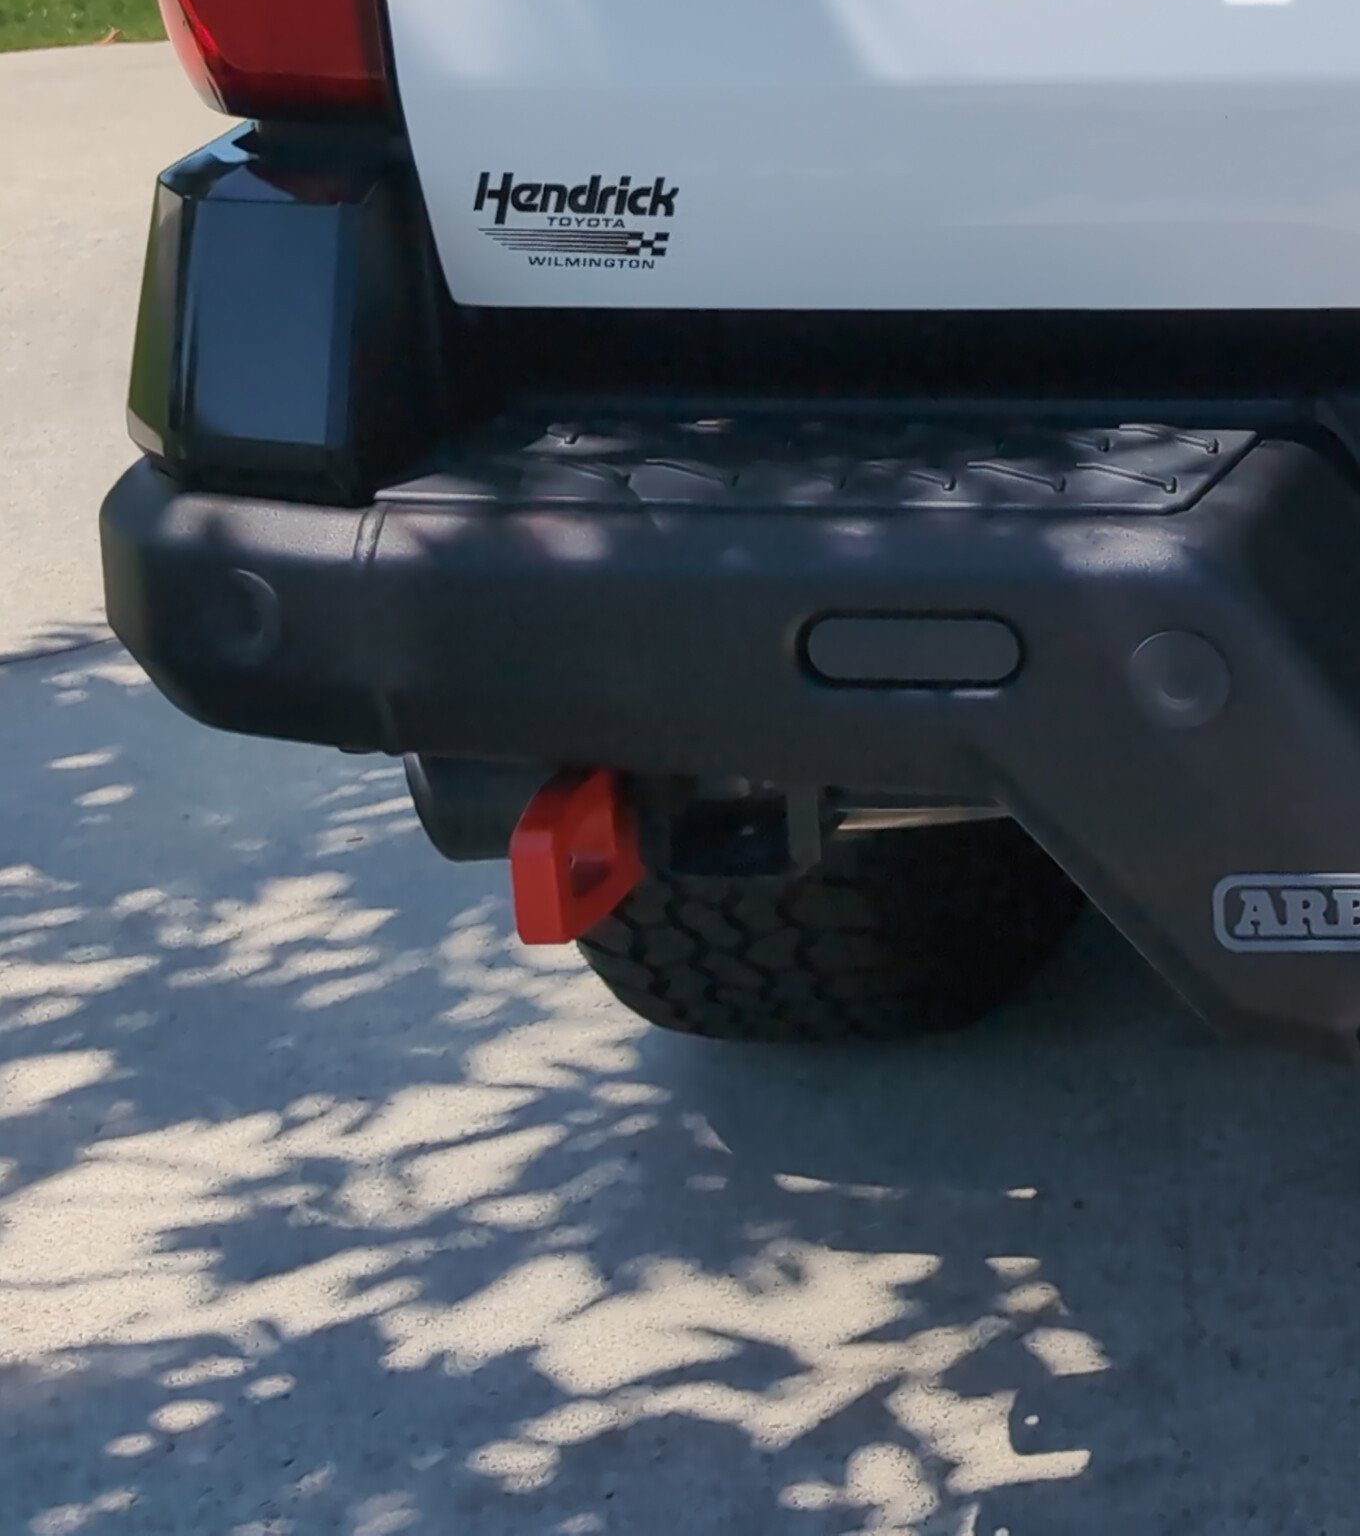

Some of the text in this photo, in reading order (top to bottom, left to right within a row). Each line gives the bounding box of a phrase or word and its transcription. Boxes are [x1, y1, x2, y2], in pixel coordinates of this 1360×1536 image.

[473, 171, 680, 226] Hendrick
[546, 216, 626, 229] TOYOTA
[528, 255, 656, 270] WILMINGTON
